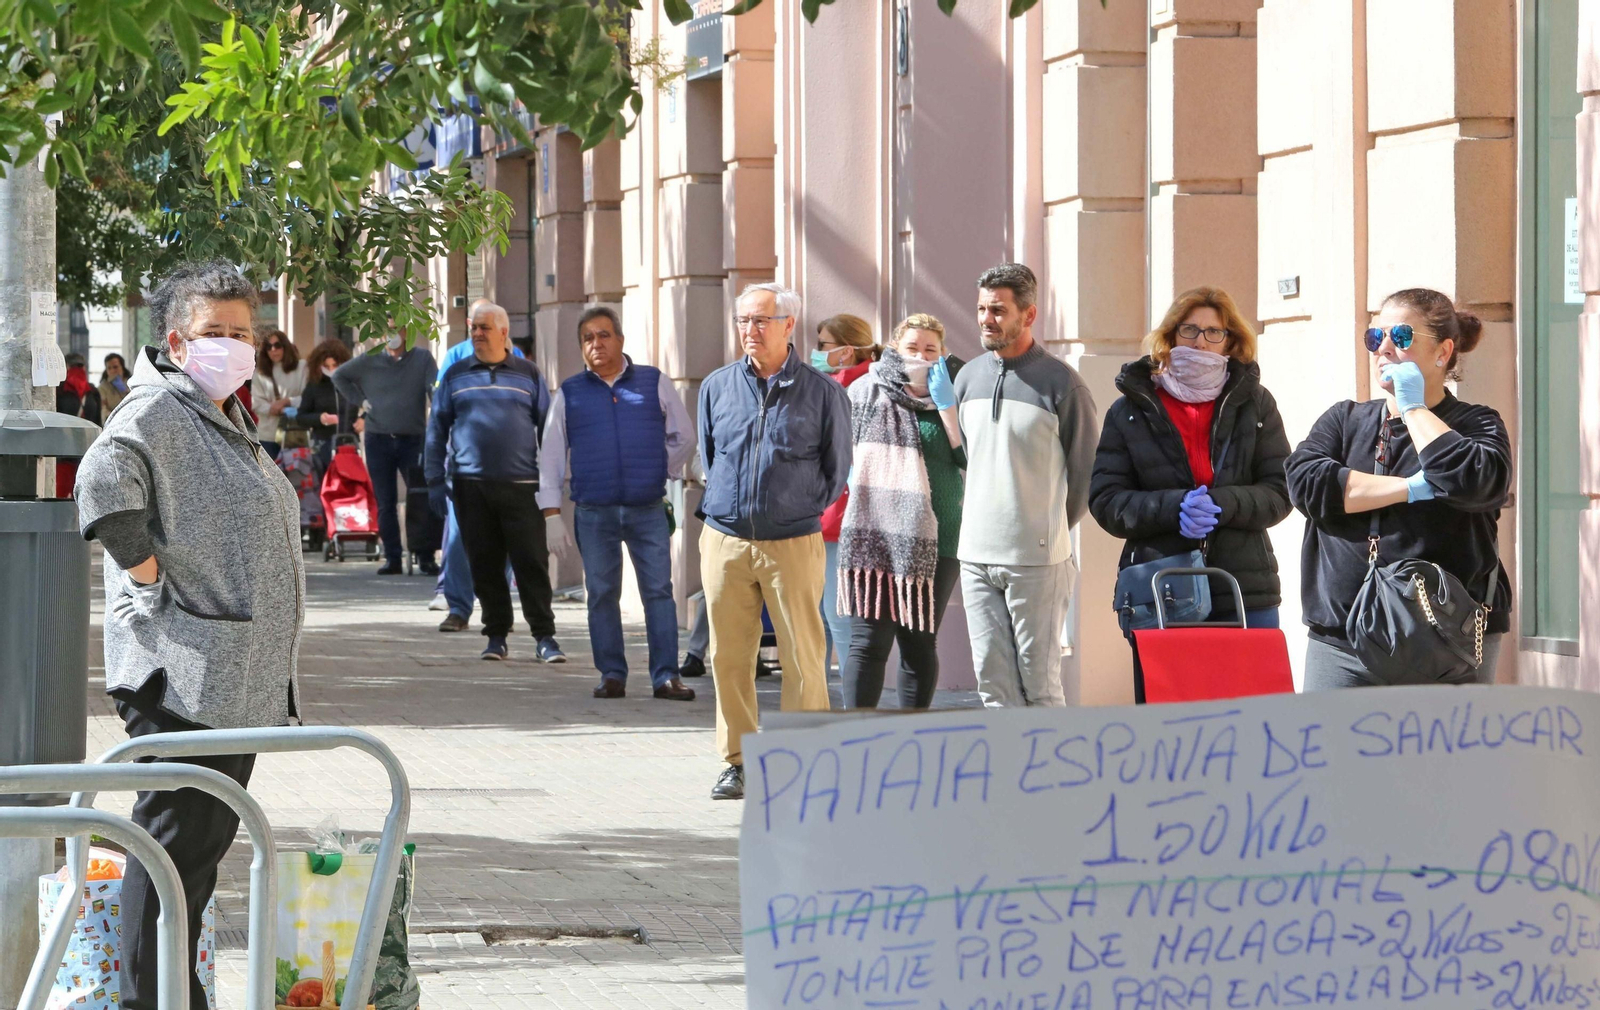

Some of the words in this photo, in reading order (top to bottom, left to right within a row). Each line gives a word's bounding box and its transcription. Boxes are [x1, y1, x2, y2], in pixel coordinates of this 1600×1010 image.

[758, 724, 993, 832] PATATA
[1262, 721, 1328, 778] DE
[1351, 702, 1583, 756] SANLUCAR
[1083, 790, 1230, 865] 1.50
[767, 884, 930, 950] PATATA
[954, 875, 1097, 930] VIEJA
[1127, 855, 1404, 918] NACIONAL
[774, 941, 935, 1006] TOMATE
[1068, 931, 1126, 971] DE
[1152, 909, 1336, 965] MALAGA
[1379, 909, 1416, 960] 2
[1228, 956, 1463, 1008] ENSALADA
[1492, 960, 1527, 1010] 2
